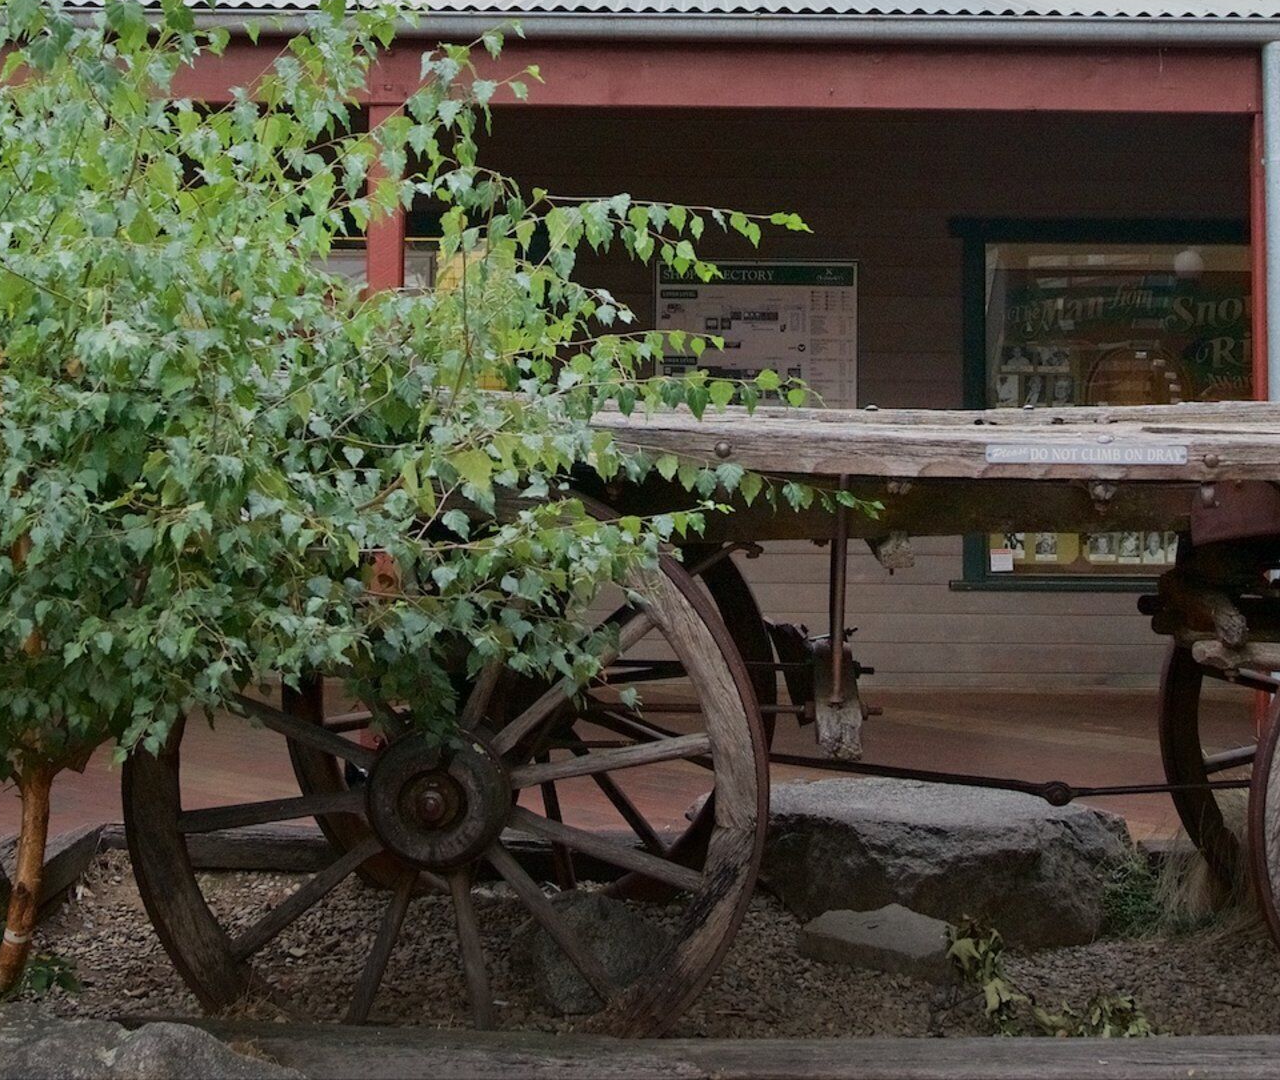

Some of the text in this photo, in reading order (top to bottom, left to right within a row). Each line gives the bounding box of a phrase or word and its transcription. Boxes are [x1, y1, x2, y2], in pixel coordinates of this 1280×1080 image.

[1164, 296, 1253, 332] Sno
[1030, 449, 1048, 460] DO
[1052, 449, 1078, 461] NOT
[1081, 449, 1121, 461] CLIMB
[1125, 449, 1143, 461] ON
[1147, 449, 1184, 461] DRAY
